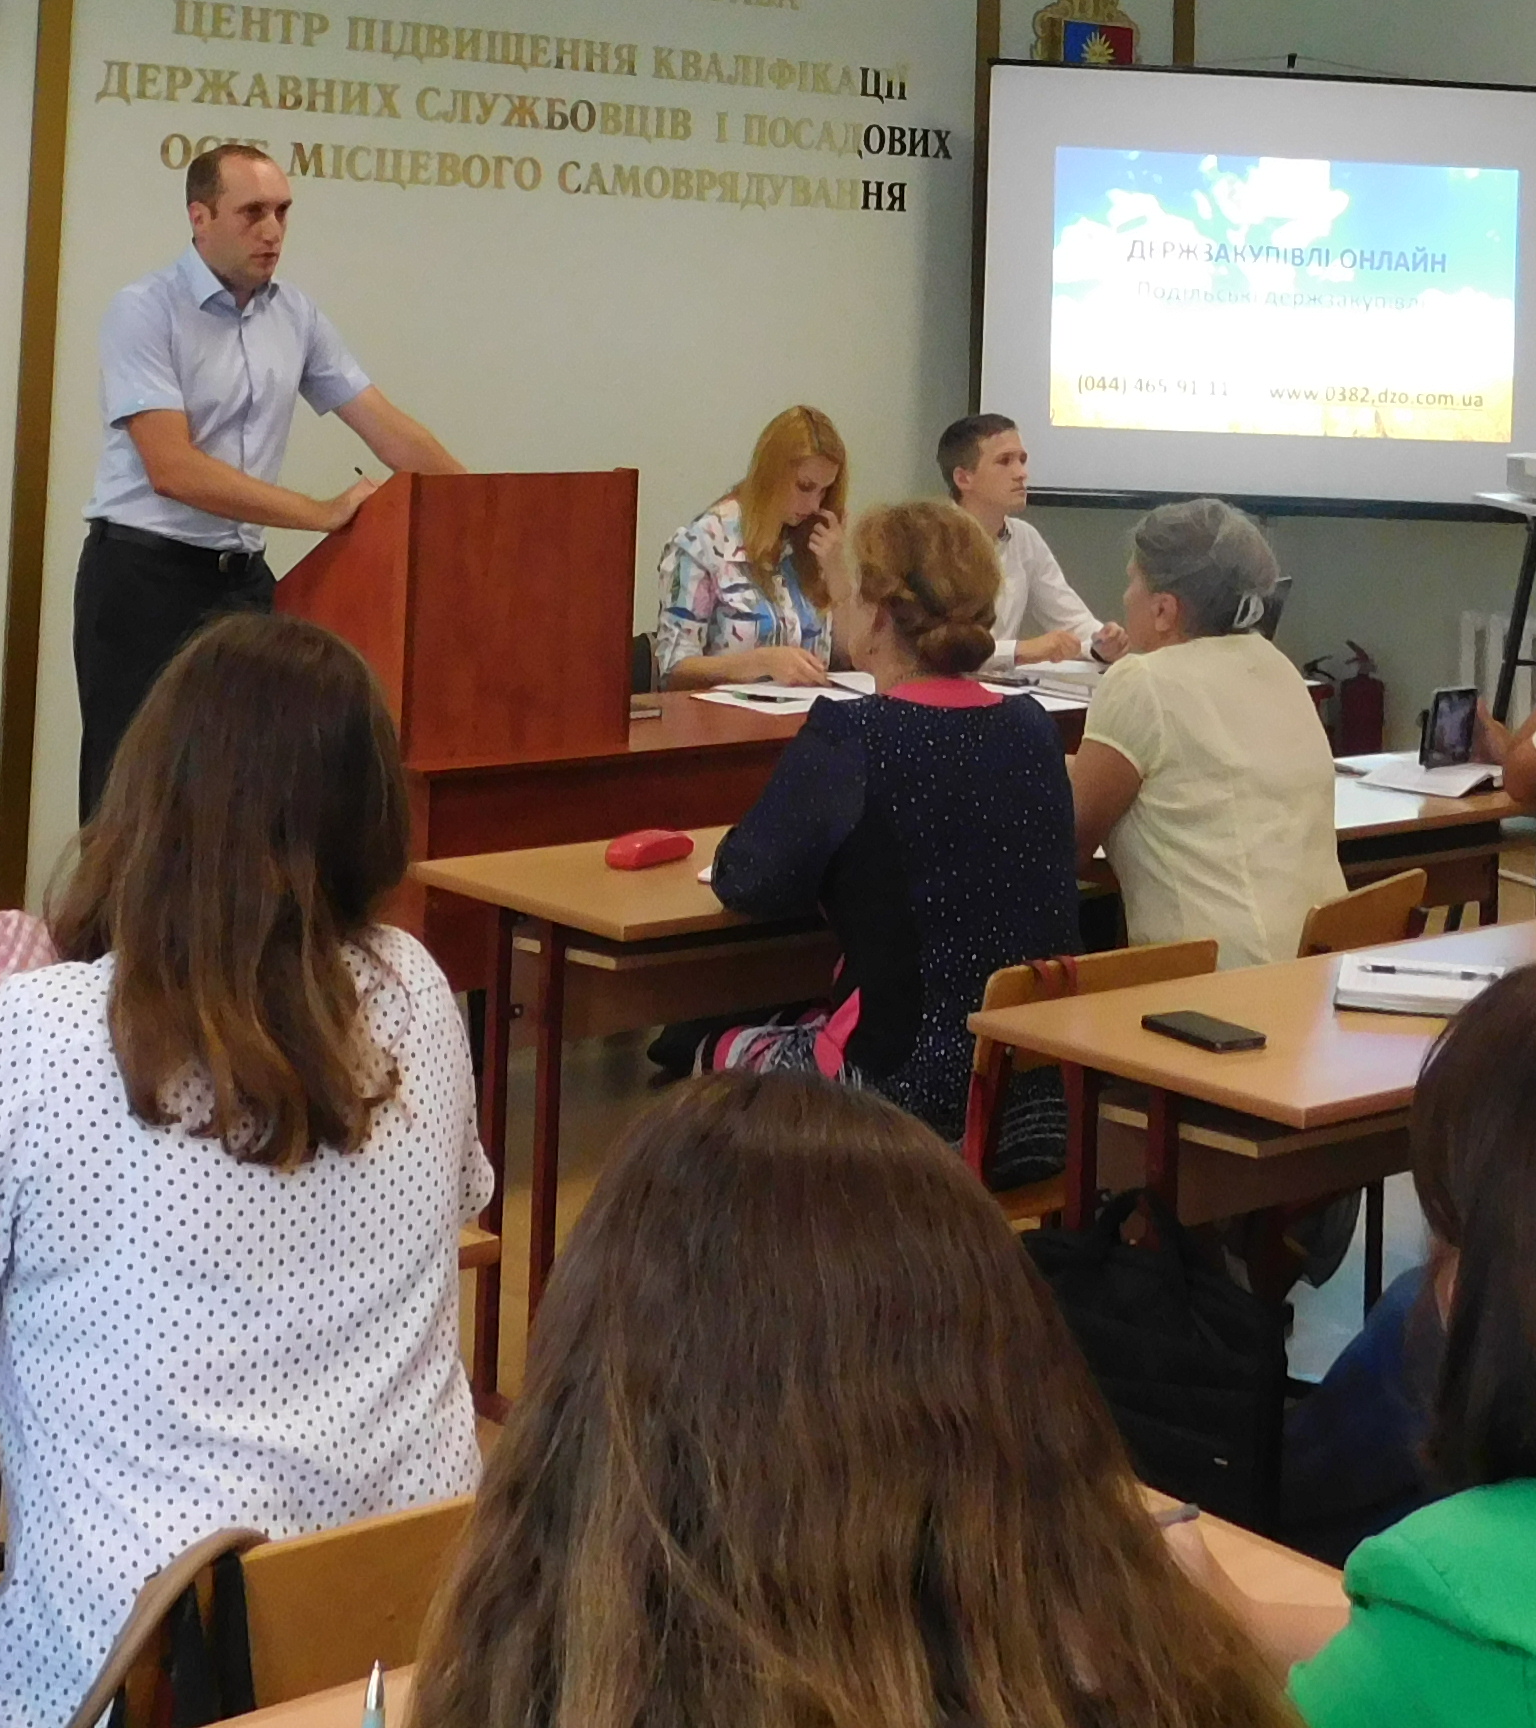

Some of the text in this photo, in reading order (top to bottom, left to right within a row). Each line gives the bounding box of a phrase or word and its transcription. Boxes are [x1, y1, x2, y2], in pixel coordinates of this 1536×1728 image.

[346, 15, 638, 77] ПІДВИЩЕННЯ
[653, 45, 910, 104] КВАЛІФІКАЦІЇ
[95, 59, 402, 120] ДЕРЖАВНИХ
[415, 86, 693, 142] СЛУЖБОВЦІВ
[743, 113, 953, 160] ПОСАДОВИХ
[288, 142, 542, 193] МІСЦЕВОГО
[557, 160, 908, 213] САМОВРЯДУВАННЯ
[1339, 246, 1448, 274] ОНЛАЙН
[1077, 373, 1128, 395] (044)
[1269, 385, 1486, 410] www0382.dzo.com.ua
